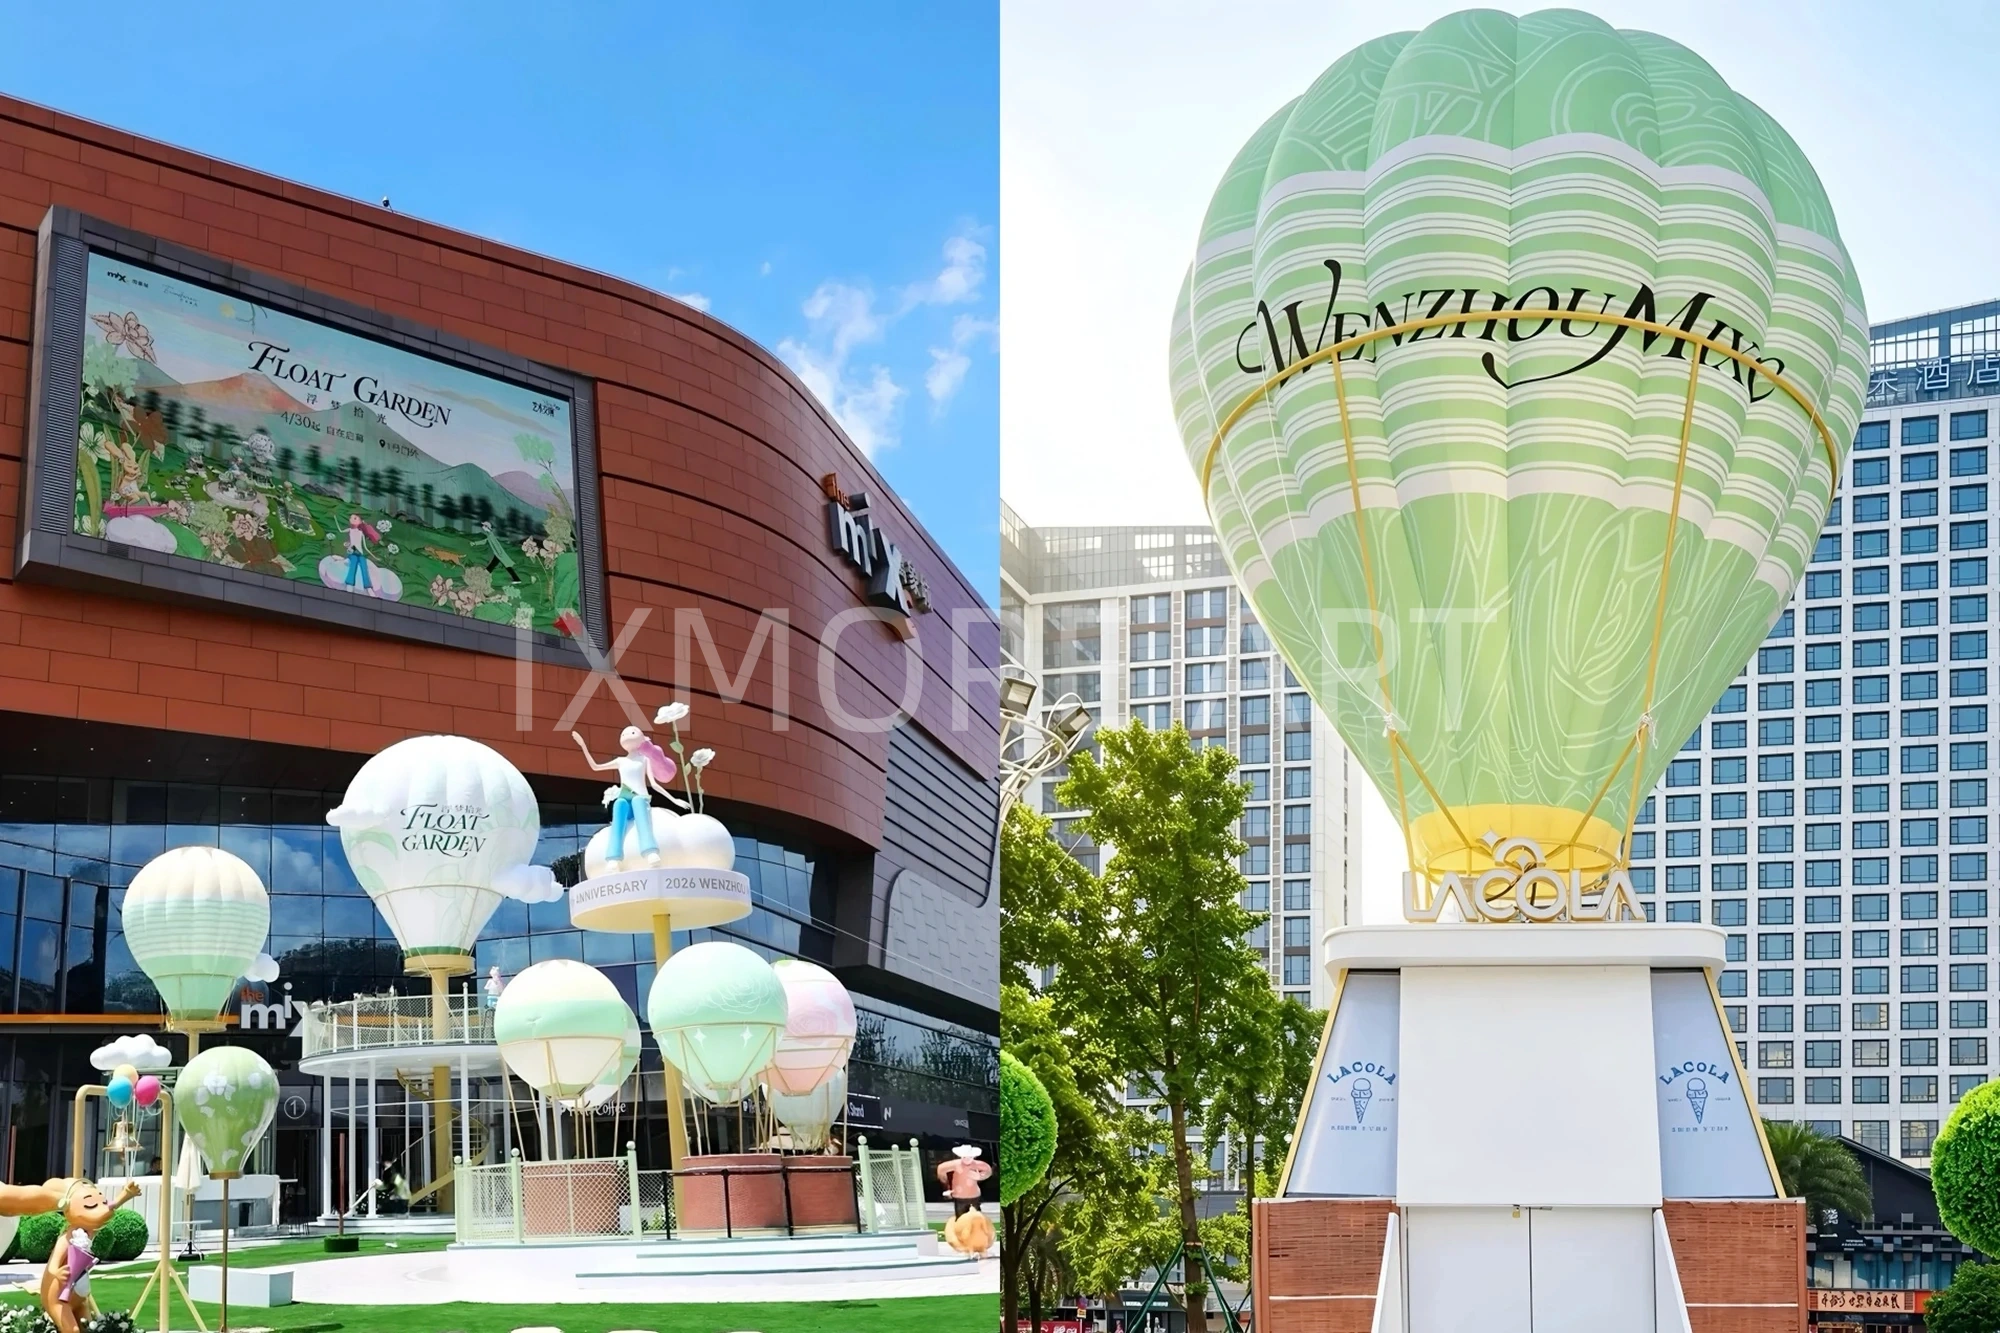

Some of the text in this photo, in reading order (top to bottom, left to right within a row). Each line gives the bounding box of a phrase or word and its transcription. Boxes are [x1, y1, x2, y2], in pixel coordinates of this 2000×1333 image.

[1236, 259, 1614, 388] WENZHOU
[248, 341, 451, 429] FLOAT GARDEN
[306, 393, 388, 426] 浮梦拾光
[400, 803, 490, 835] FLOAT
[402, 834, 487, 858] GARDEN
[576, 877, 746, 904] ANNIVERSARY 2026 WENZHOU
[1402, 868, 1647, 923] LACOLA
[241, 985, 265, 1002] the
[1327, 1061, 1396, 1086] LACOLA
[1659, 1061, 1730, 1086] LACOLA
